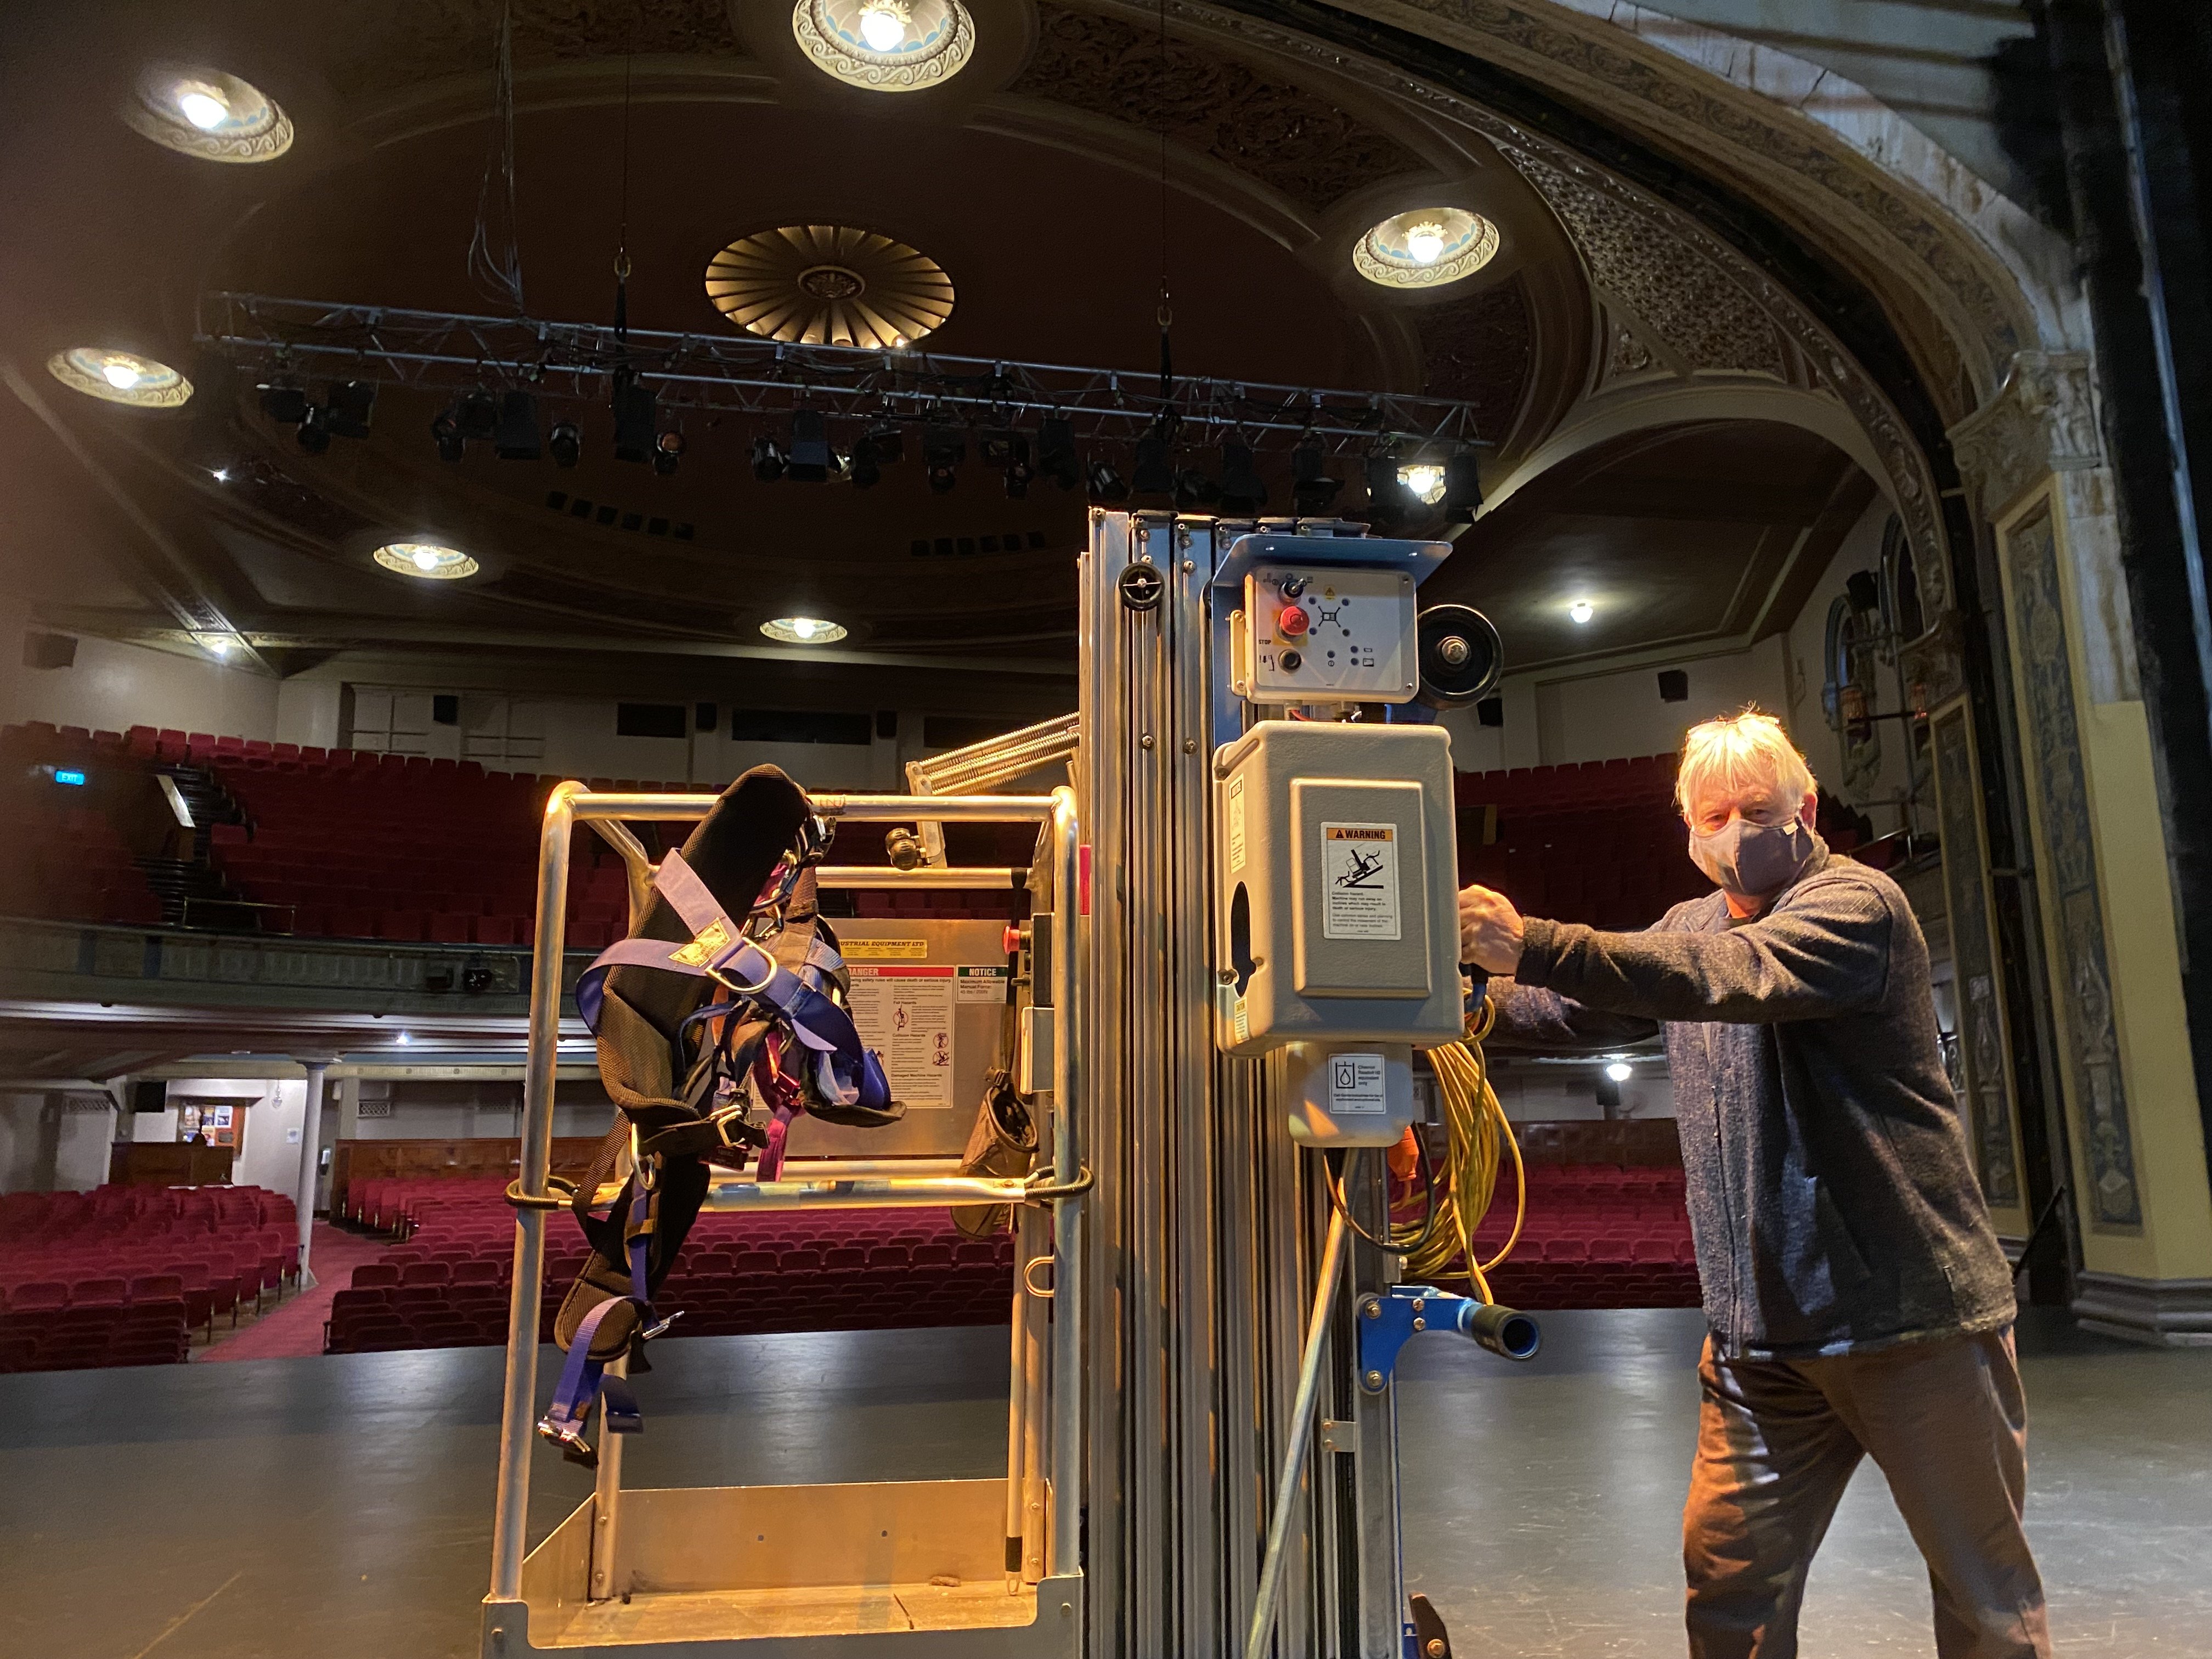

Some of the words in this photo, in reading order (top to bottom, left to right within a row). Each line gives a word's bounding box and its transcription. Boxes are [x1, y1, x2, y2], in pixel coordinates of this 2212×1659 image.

[61, 772, 78, 782] EXIT
[1345, 830, 1386, 839] WARNING
[969, 968, 996, 977] NOTICE
